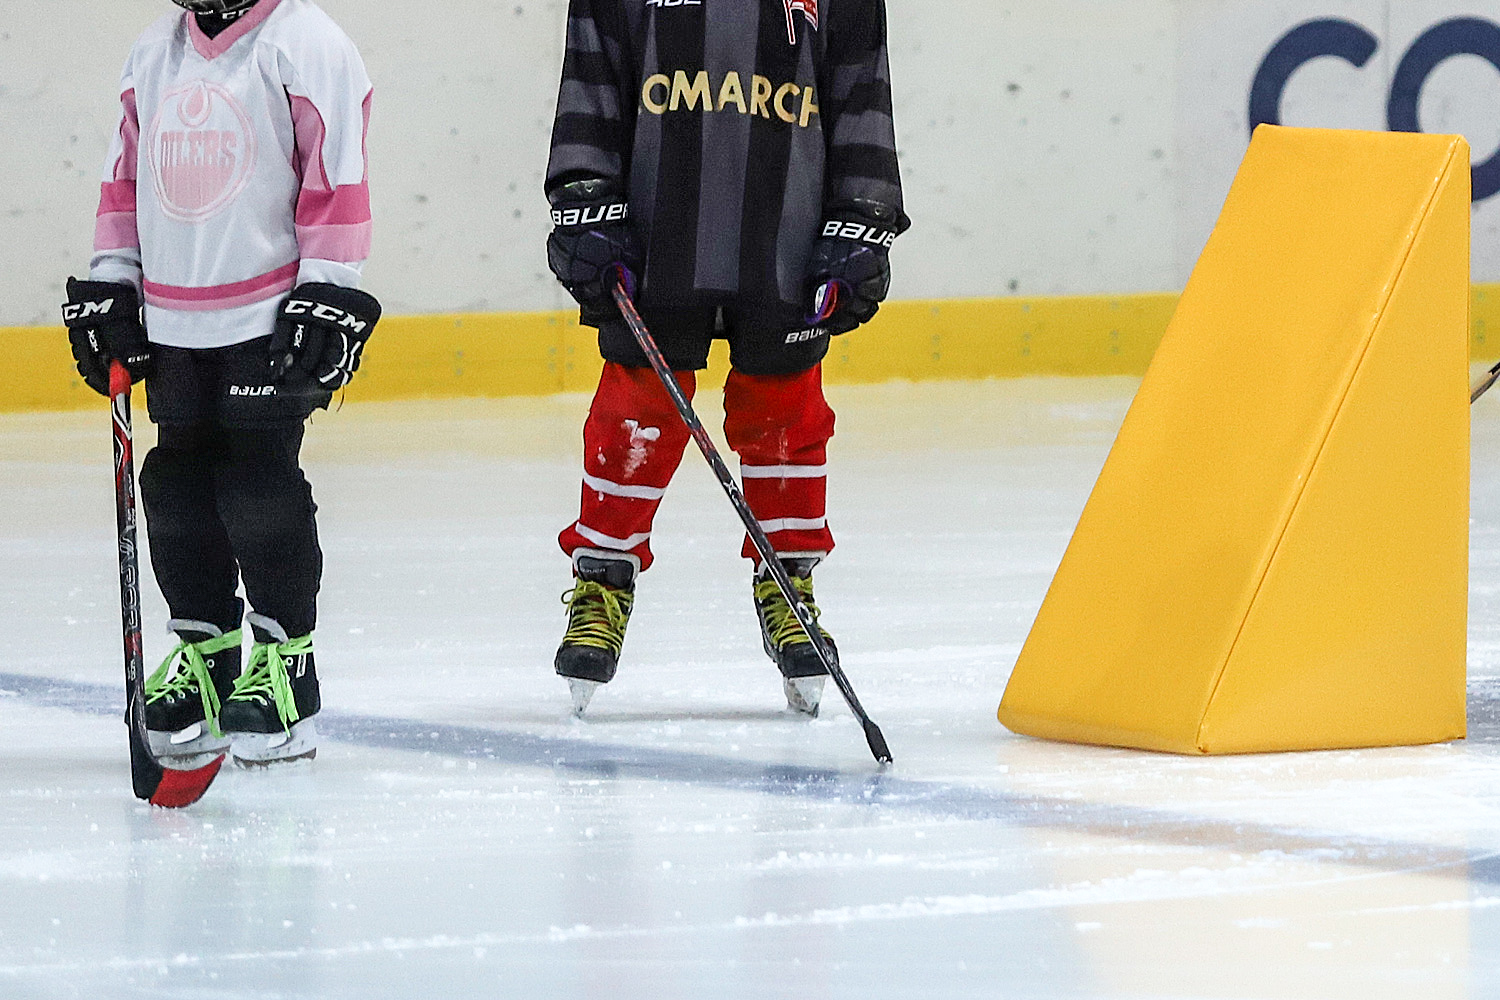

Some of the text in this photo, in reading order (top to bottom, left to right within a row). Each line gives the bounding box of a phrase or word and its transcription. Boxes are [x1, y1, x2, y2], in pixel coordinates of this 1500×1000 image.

[160, 130, 238, 168] OILERS
[284, 299, 367, 334] CCM
[229, 384, 277, 397] BAUE
